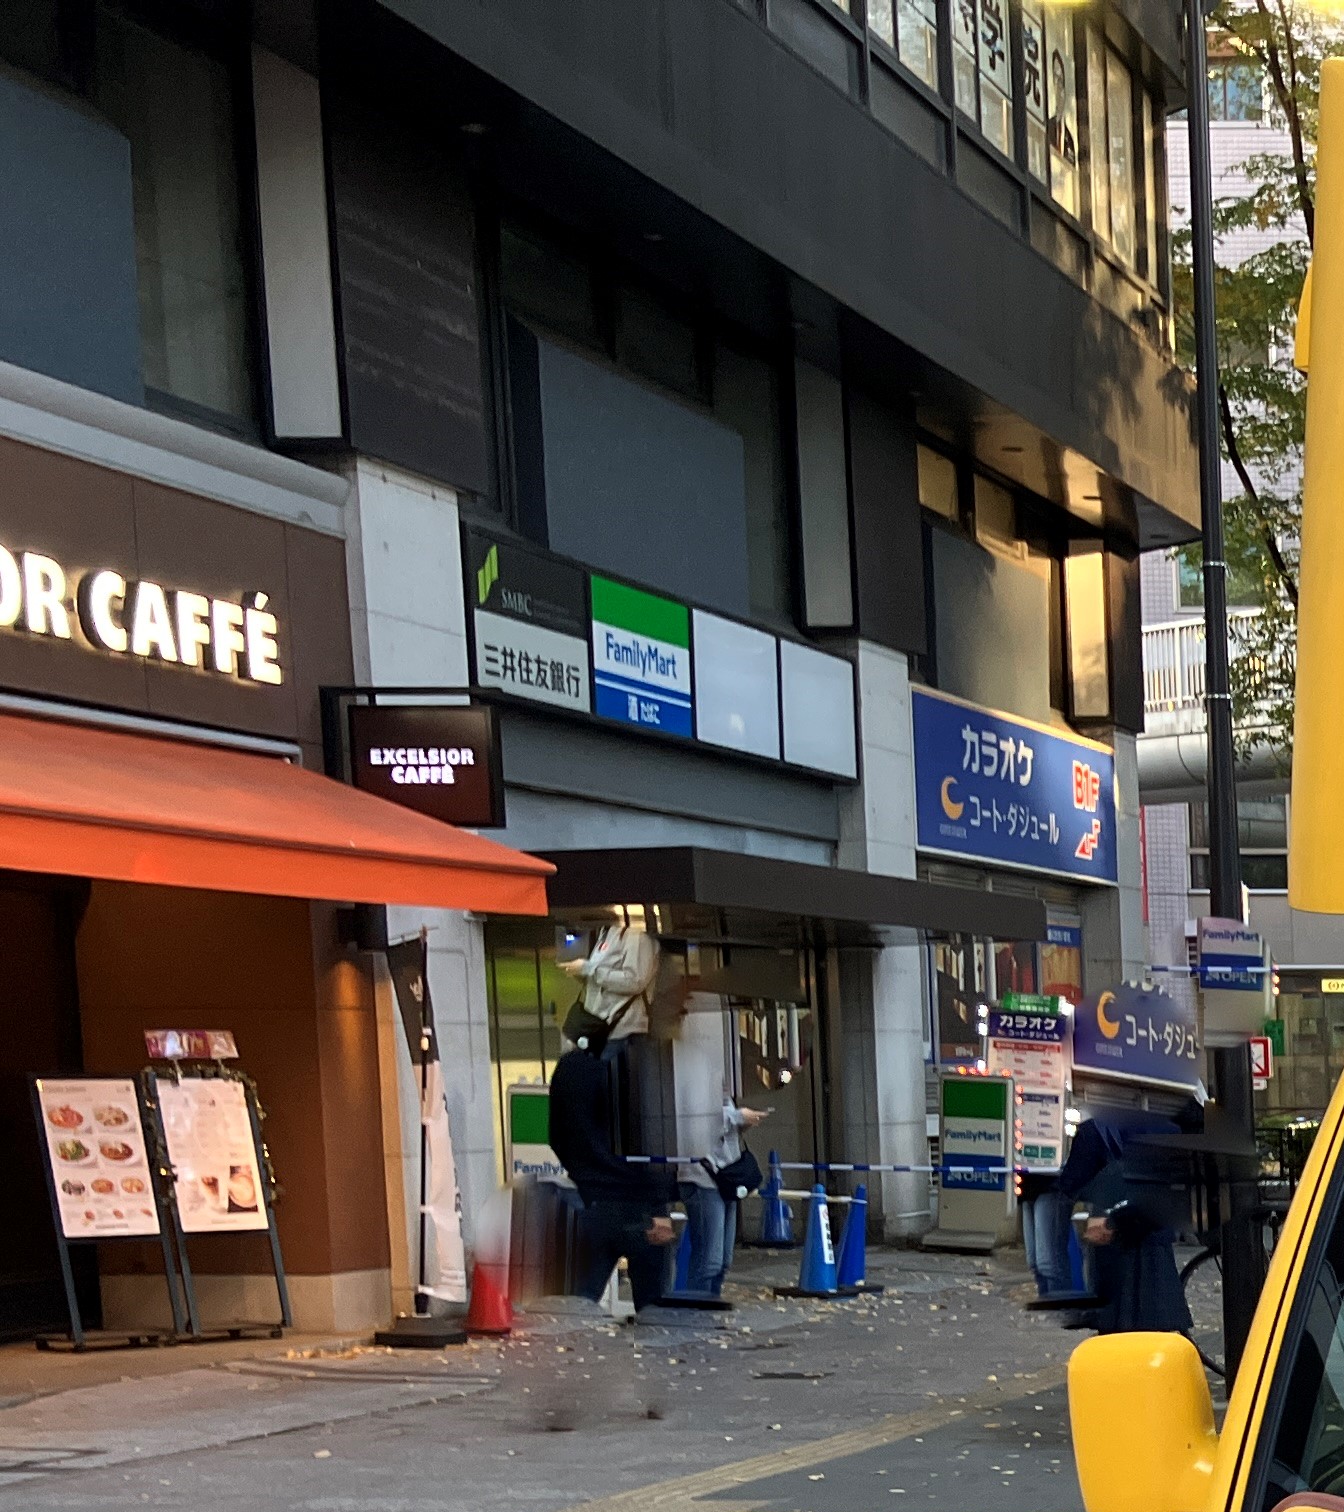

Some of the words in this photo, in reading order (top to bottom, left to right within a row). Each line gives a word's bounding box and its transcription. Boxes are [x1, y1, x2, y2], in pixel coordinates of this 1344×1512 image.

[500, 587, 533, 617] SMBC
[84, 570, 283, 685] CAFFÉ
[484, 643, 581, 698] 三井住友銀行
[605, 631, 677, 680] FamilyMart
[370, 747, 474, 766] EXCELSIOR
[962, 724, 1034, 787] カラオケ
[1072, 760, 1100, 812] B1F
[969, 795, 1060, 845] コート・ダジュール
[1203, 928, 1259, 943] FamilyMart
[1222, 970, 1257, 984] OPEN
[1000, 1015, 1056, 1030] カラオケ
[945, 1129, 1002, 1143] FamilyMart
